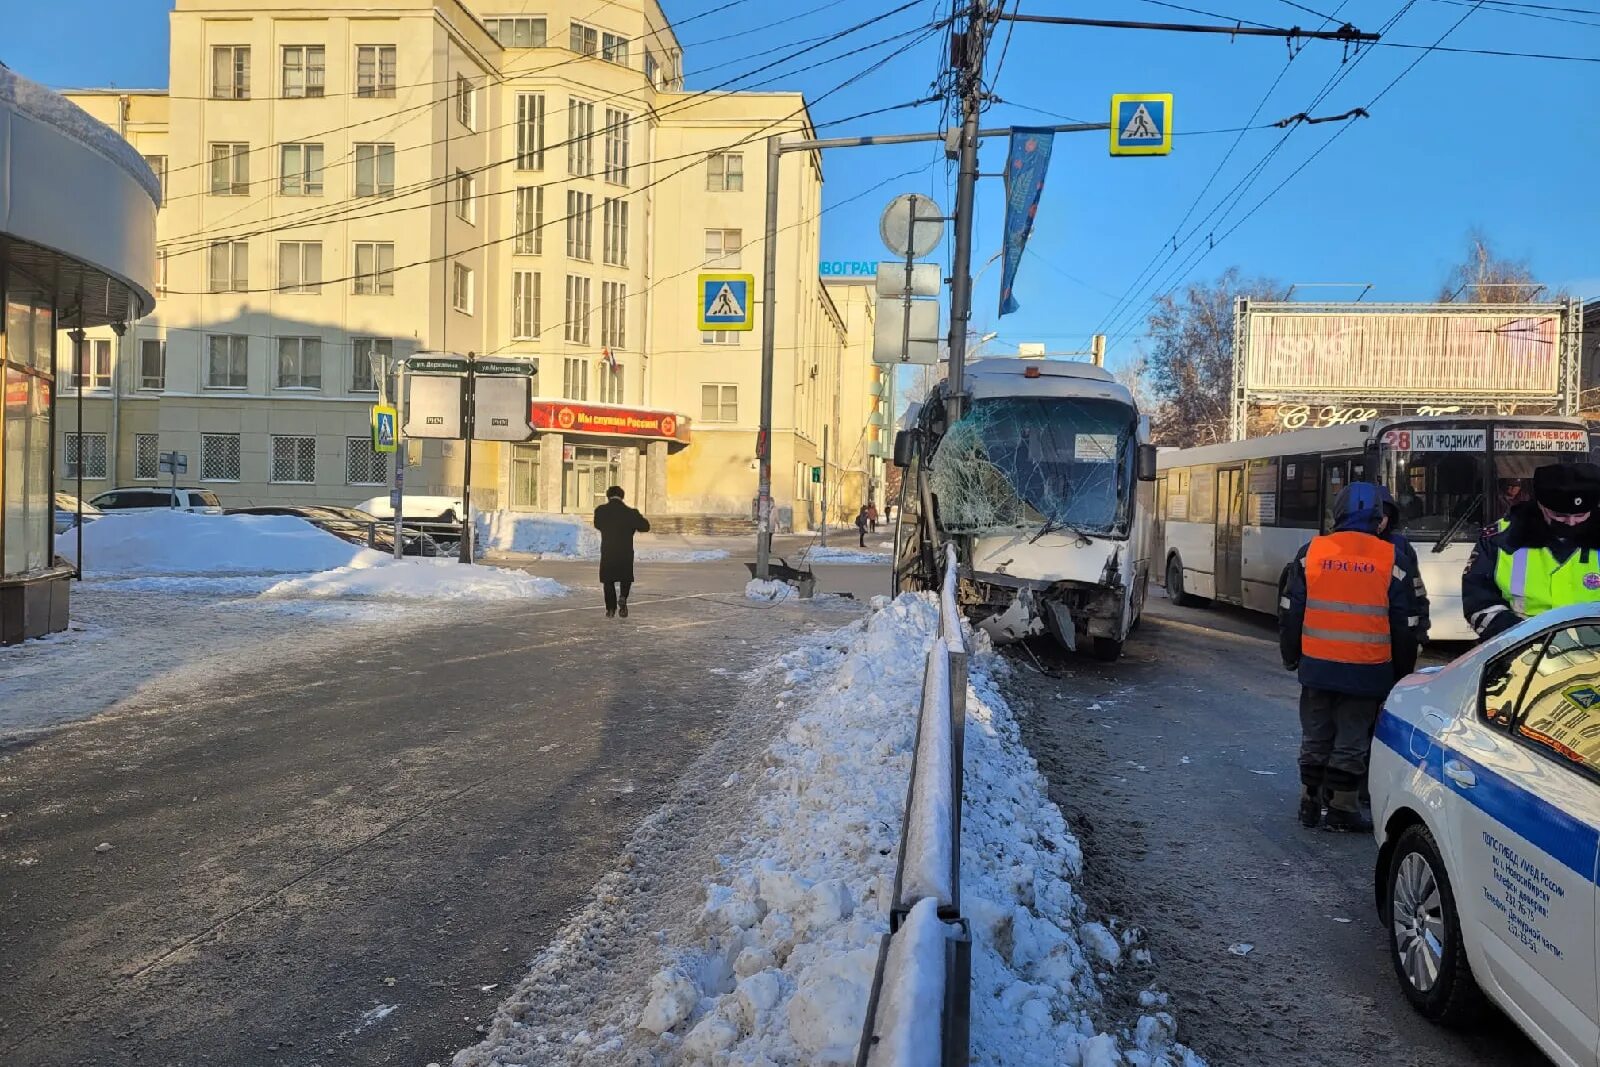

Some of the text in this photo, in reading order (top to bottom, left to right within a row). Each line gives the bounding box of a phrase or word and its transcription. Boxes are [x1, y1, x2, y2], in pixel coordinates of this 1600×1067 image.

[819, 261, 878, 275] ВОГРАД
[577, 412, 592, 424] Мы
[627, 417, 659, 430] России!
[1385, 431, 1411, 451] 28
[1416, 434, 1434, 449] ЖМ
[1494, 430, 1506, 440] ТК
[1556, 441, 1587, 452] ПРОСТОР
[1505, 863, 1551, 903] Новосибирску
